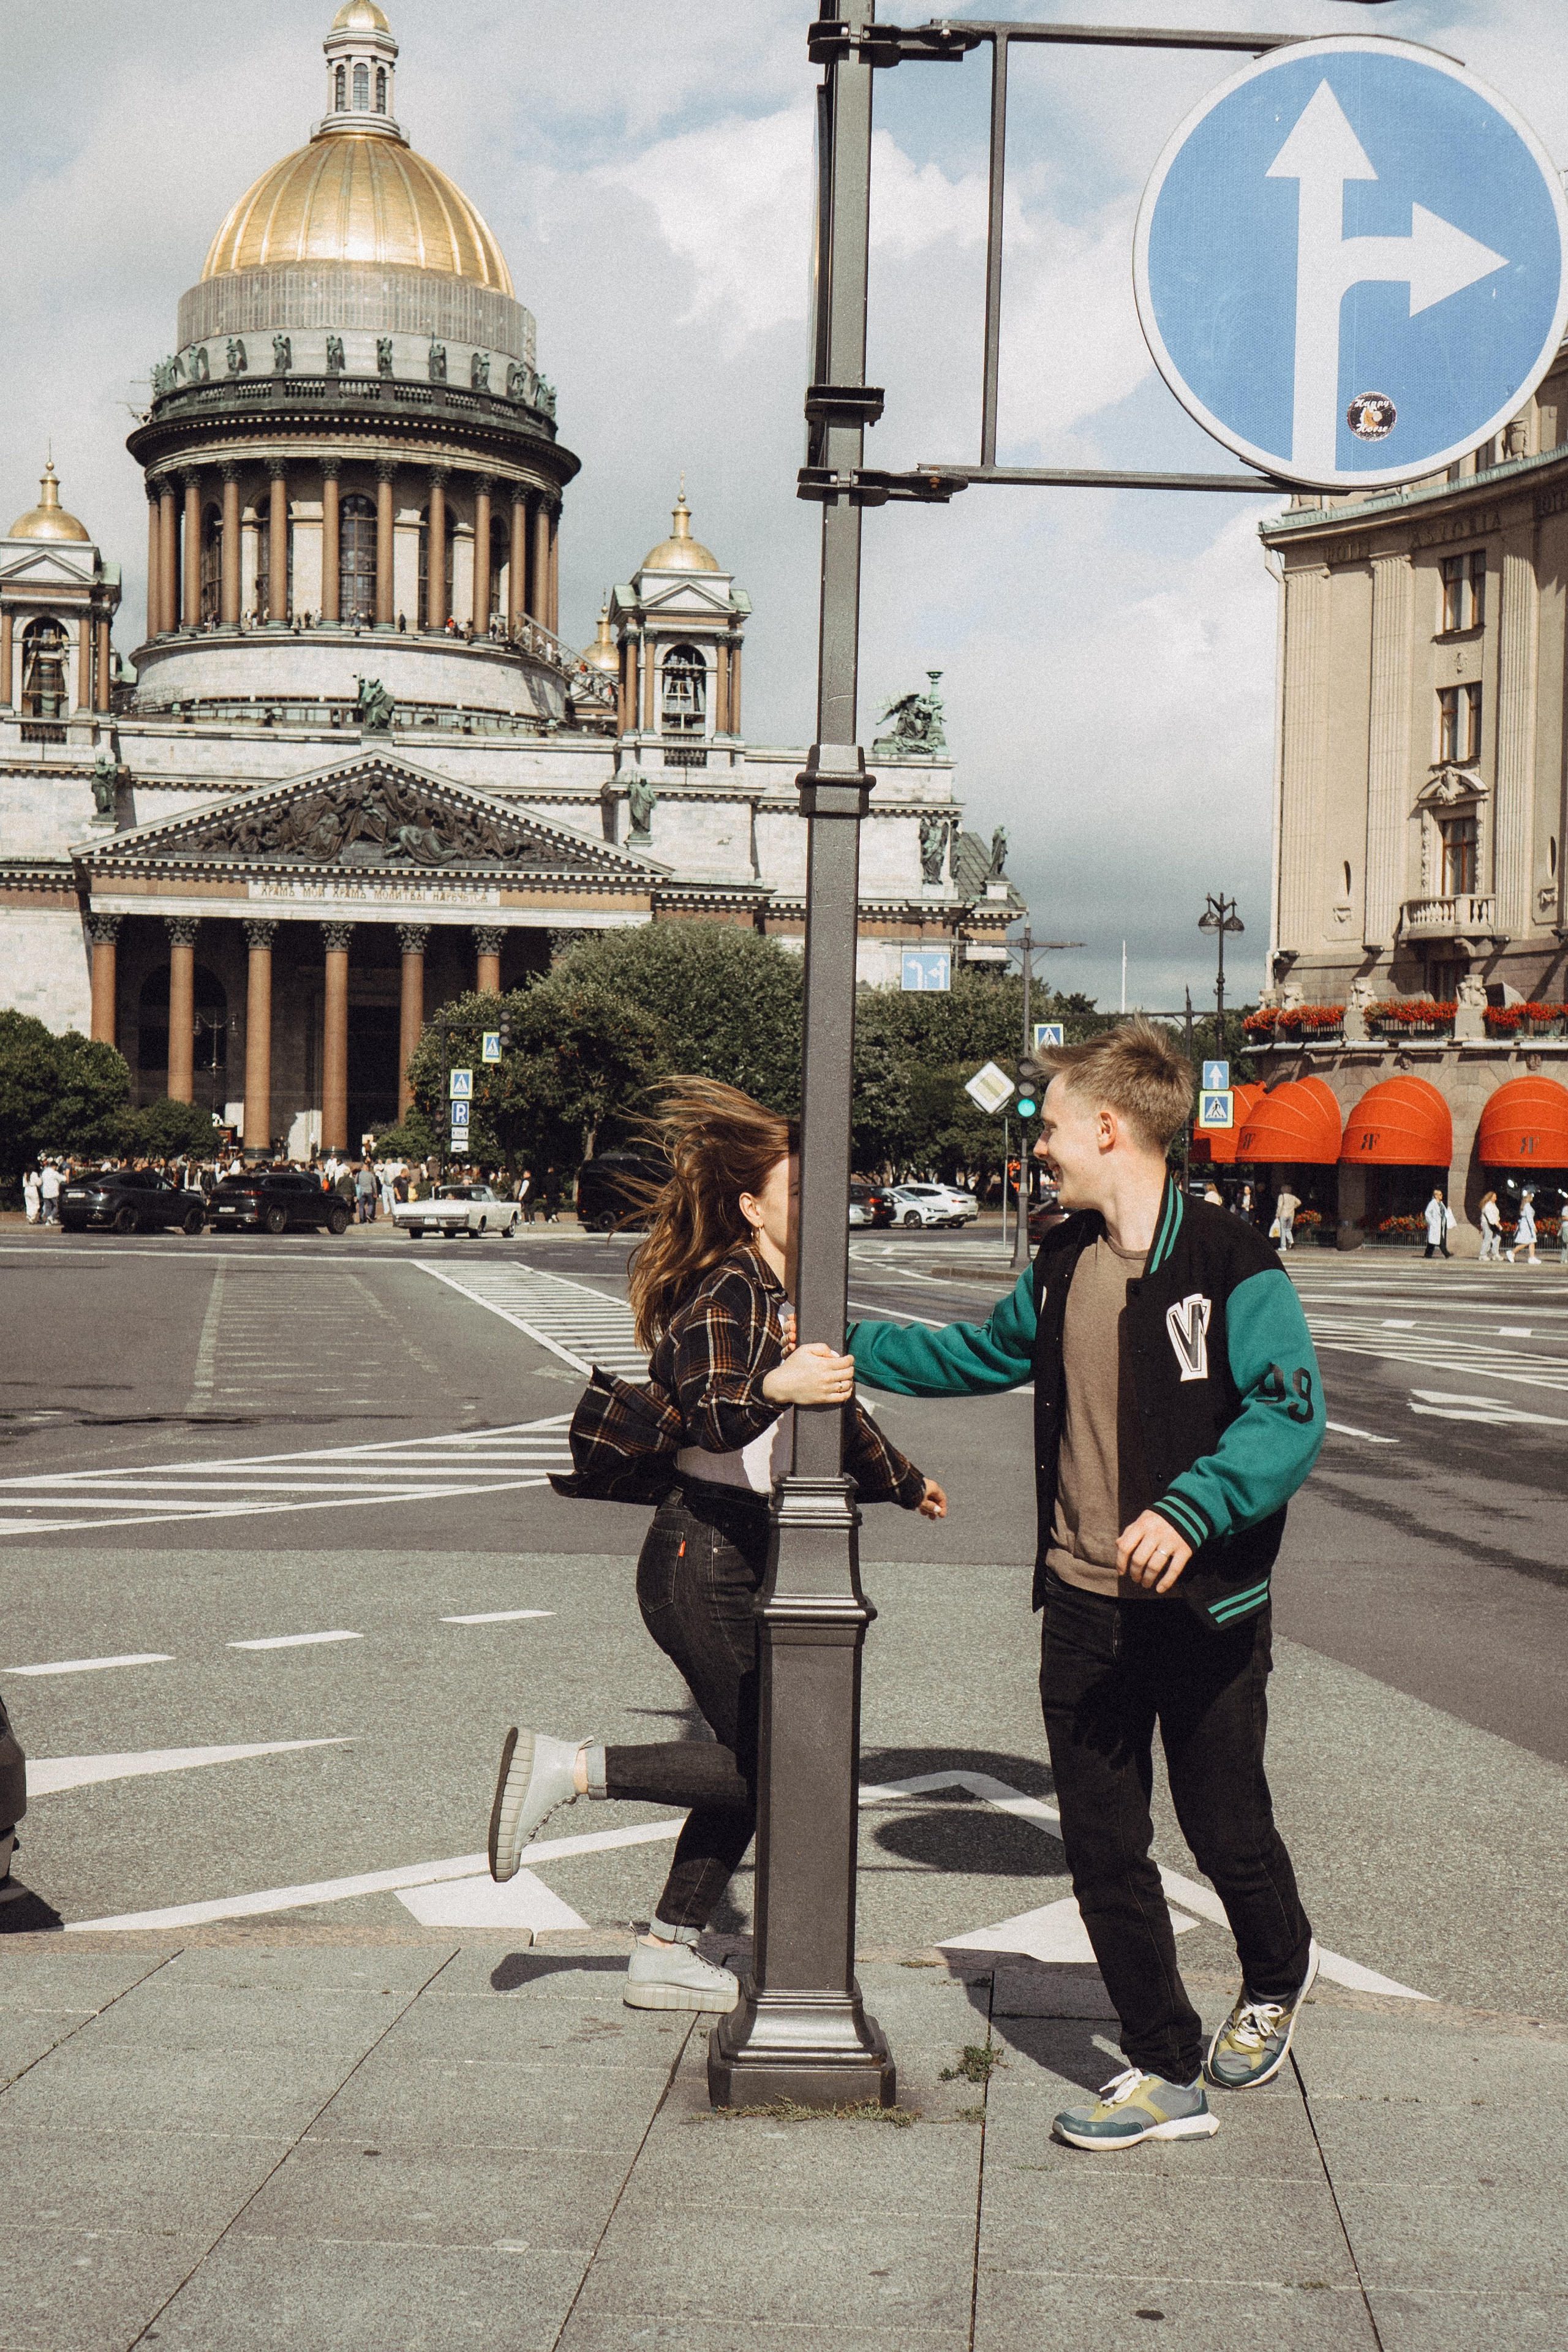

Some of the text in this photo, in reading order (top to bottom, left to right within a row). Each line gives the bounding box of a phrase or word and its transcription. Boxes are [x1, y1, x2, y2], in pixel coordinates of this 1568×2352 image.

[1354, 399, 1390, 412] Happy
[1355, 423, 1389, 433] Horse
[456, 1104, 466, 1122] P
